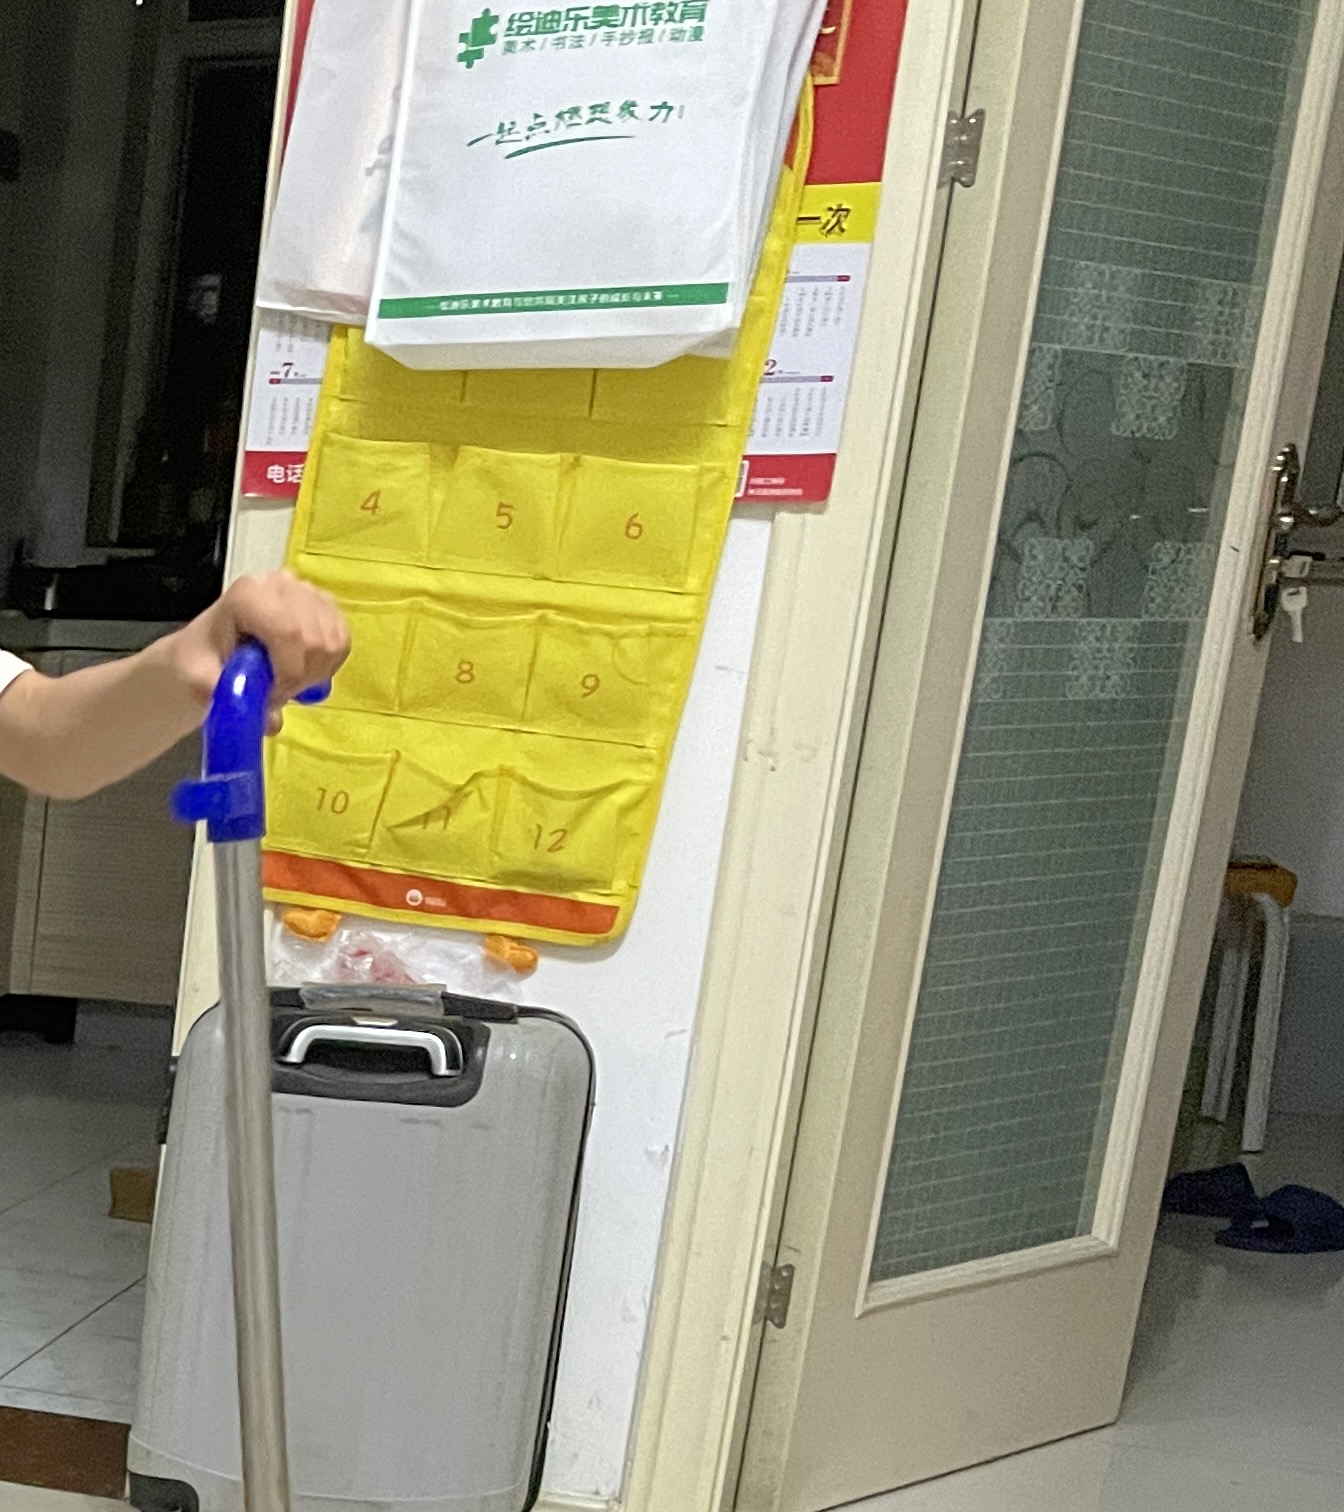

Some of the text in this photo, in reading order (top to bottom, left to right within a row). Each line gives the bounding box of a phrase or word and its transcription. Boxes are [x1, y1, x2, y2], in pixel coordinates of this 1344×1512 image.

[503, 0, 710, 37] 绘迪乐美术教育
[795, 203, 851, 237] 一次
[266, 464, 305, 484] 电话
[360, 489, 381, 515] 4
[495, 501, 516, 530] 5
[624, 512, 643, 540] 6
[454, 660, 475, 684] 8
[580, 673, 600, 698] 9
[316, 786, 350, 814] 10
[533, 824, 567, 853] 12
